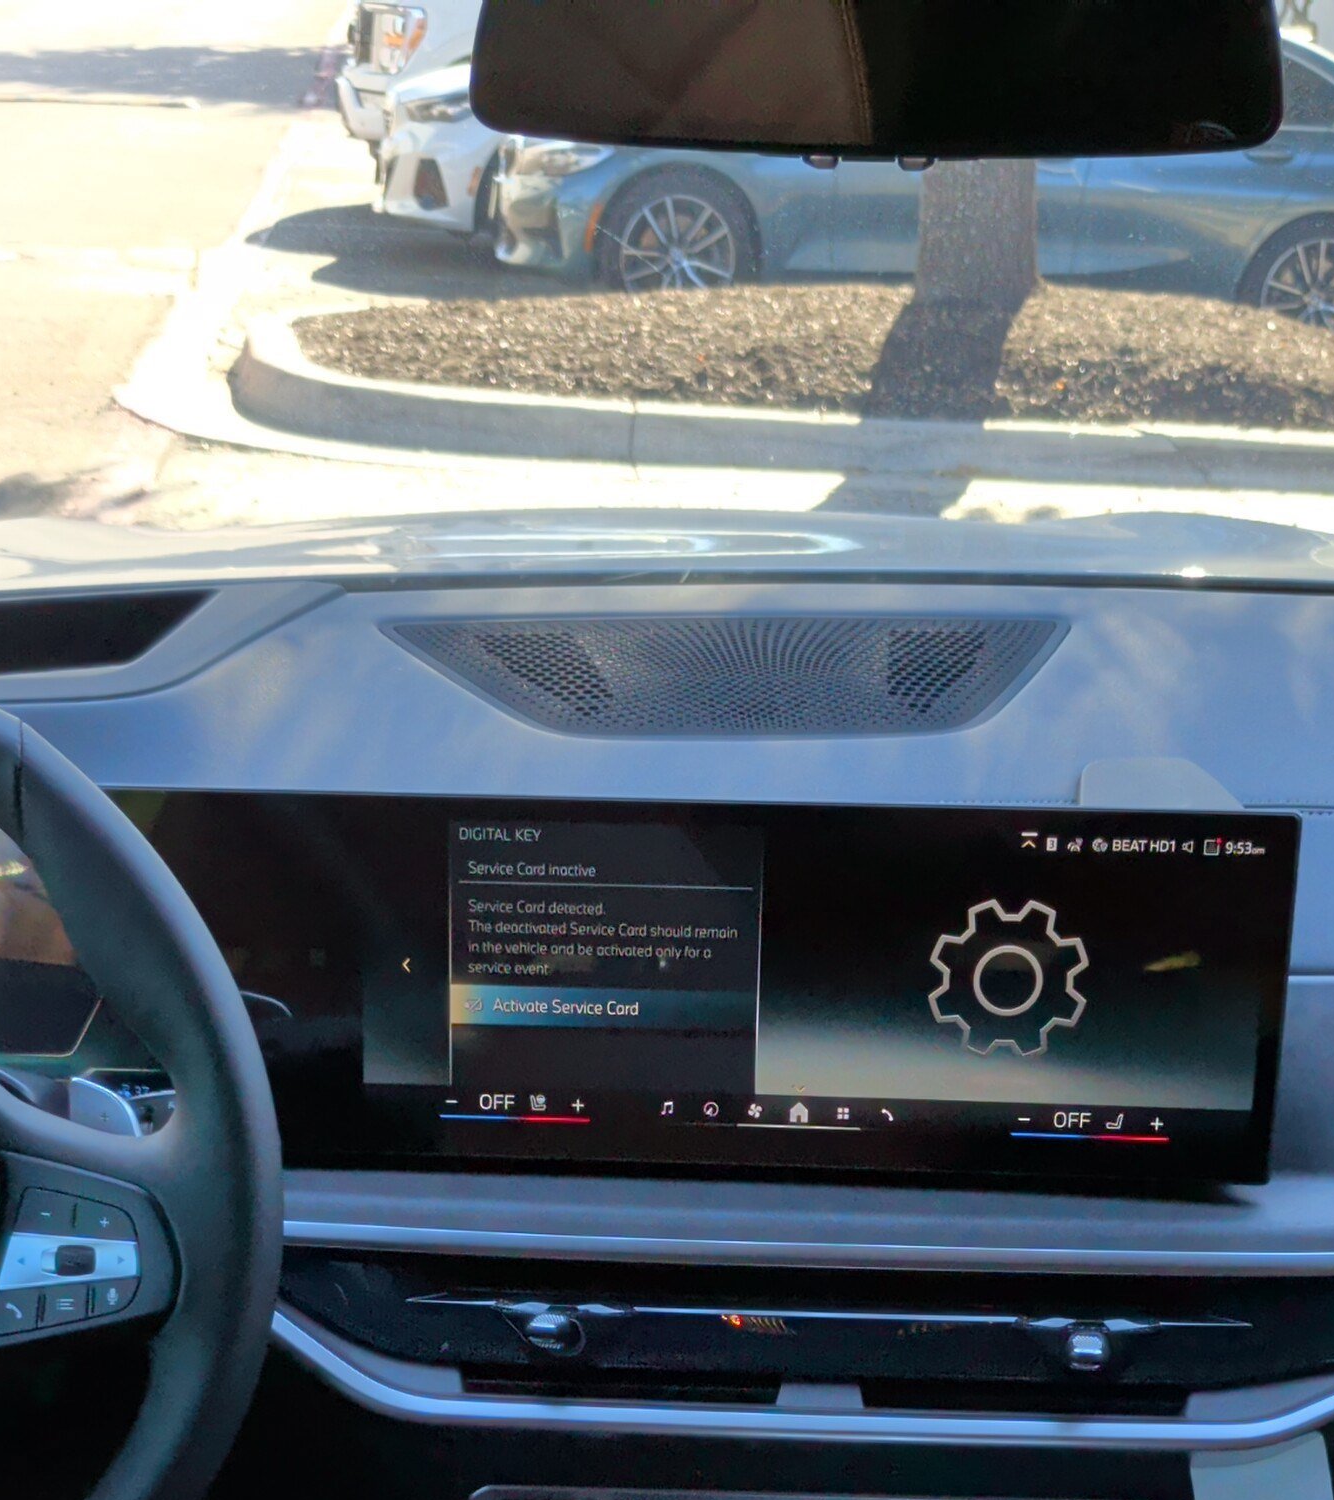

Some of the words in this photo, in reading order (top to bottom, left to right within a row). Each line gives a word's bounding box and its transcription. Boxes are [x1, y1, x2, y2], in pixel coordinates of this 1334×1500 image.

[459, 828, 512, 841] DIGITAL
[515, 829, 541, 842] KEY
[1112, 840, 1147, 852] BEAT
[1149, 841, 1175, 852] HD1
[468, 862, 513, 876] Service
[517, 863, 546, 876] Card
[548, 864, 596, 878] inactive
[468, 900, 513, 914] Service
[516, 901, 545, 915] Card
[548, 902, 606, 916] detected.
[468, 920, 492, 934] The
[495, 921, 567, 937] deactivated
[569, 923, 615, 937] Service
[618, 924, 647, 938] Card
[650, 924, 691, 939] should
[694, 926, 738, 940] remain
[468, 941, 479, 954] in
[481, 941, 503, 955] the
[505, 942, 548, 956] vehicle
[550, 943, 575, 956] and
[577, 944, 594, 957] be
[596, 944, 652, 958] activated
[656, 945, 681, 961] only
[468, 962, 511, 975] service
[493, 998, 548, 1015] Activate
[552, 1000, 603, 1016] Service
[606, 1001, 639, 1017] Card
[479, 1095, 515, 1109] OFF
[1053, 1112, 1091, 1129] OFF
